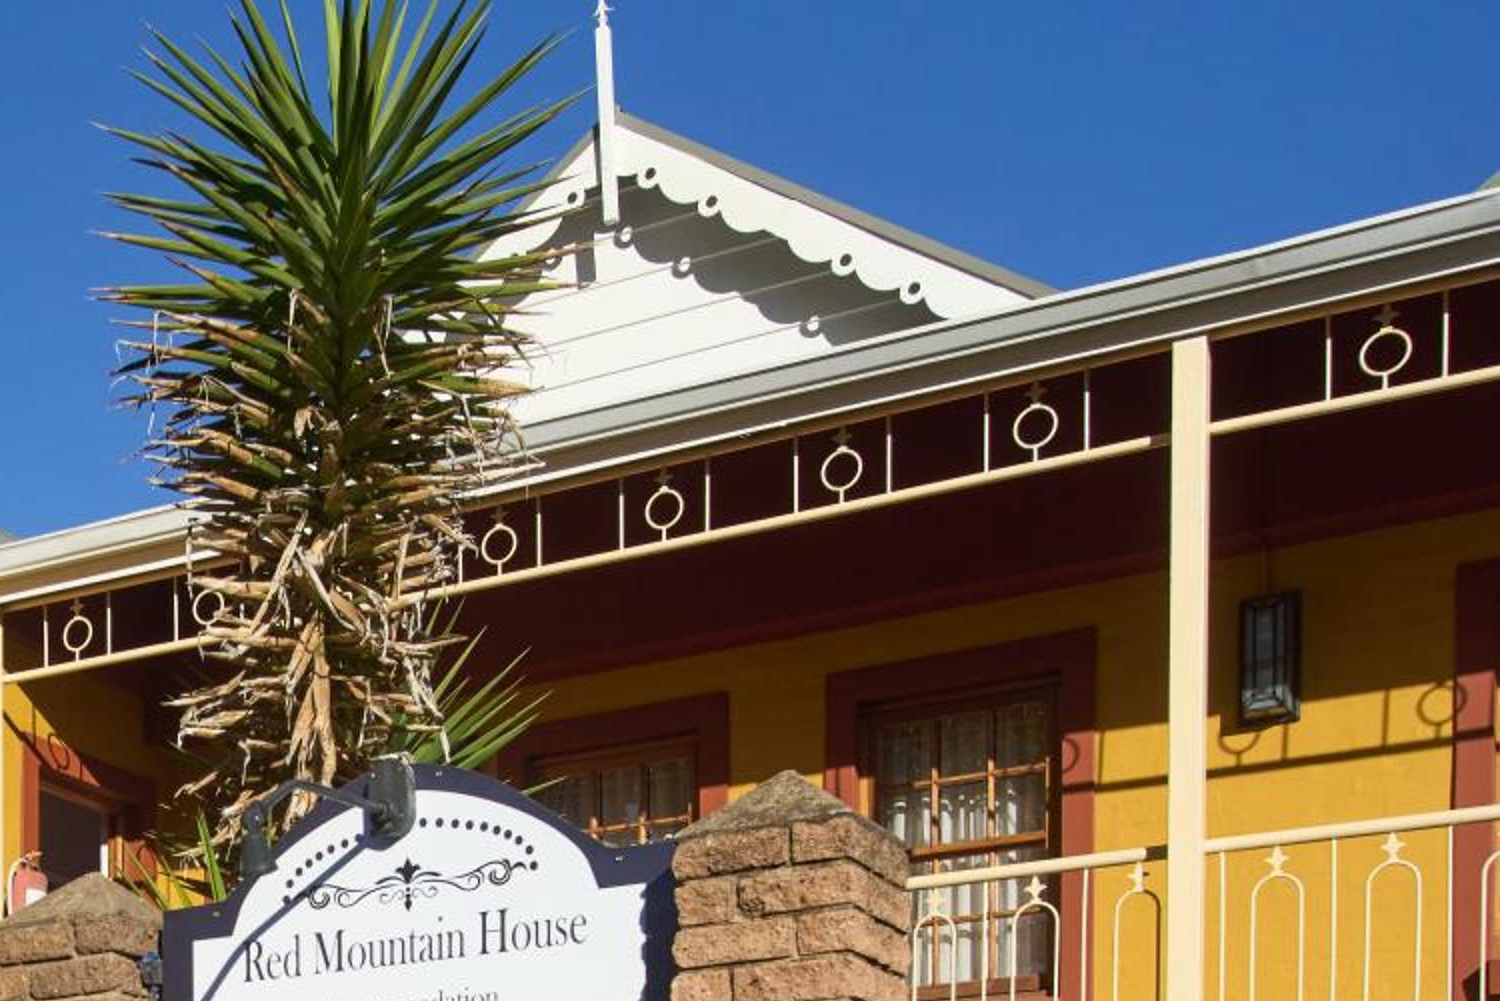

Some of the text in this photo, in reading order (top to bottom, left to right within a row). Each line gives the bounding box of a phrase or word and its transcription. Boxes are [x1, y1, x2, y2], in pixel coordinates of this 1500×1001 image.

[243, 908, 588, 983] Red Mountain House
